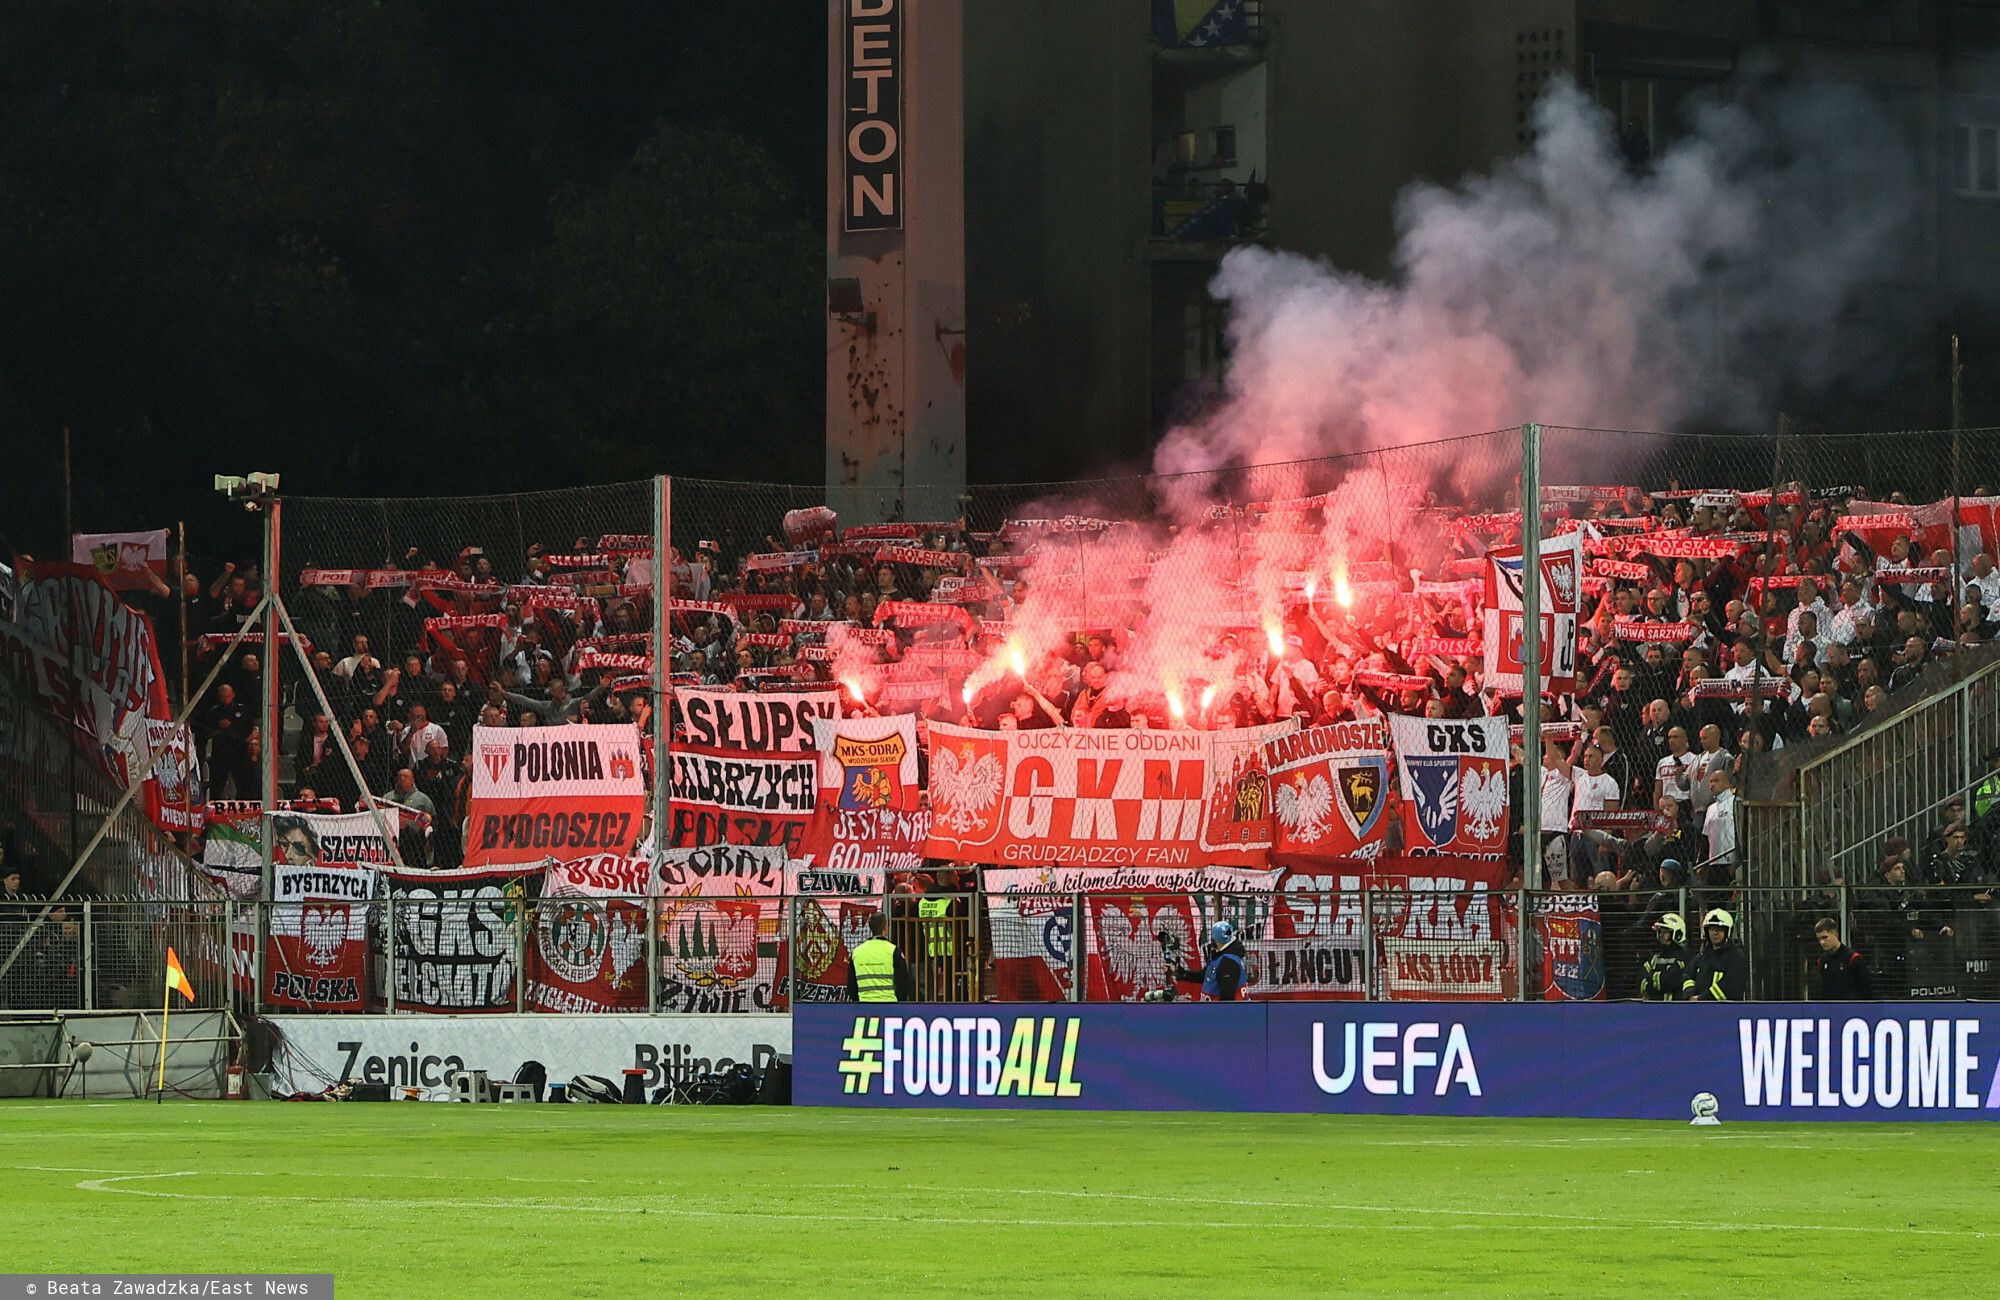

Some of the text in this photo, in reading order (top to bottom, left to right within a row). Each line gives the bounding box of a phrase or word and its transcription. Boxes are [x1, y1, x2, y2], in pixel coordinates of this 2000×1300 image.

[1615, 623, 1645, 639] NOWA
[841, 743, 899, 757] MKS ODRA
[1125, 733, 1201, 751] ODDANI
[1265, 721, 1385, 767] KARKONOSZE
[1427, 724, 1486, 753] GKS
[513, 740, 604, 783] POLONIA
[1007, 756, 1205, 841] GKM
[481, 811, 631, 850] BYDGOSZCZ
[833, 808, 880, 840] JEST
[1004, 844, 1189, 865] GRUDZIĄDZCY FANI
[282, 872, 368, 899] BYSTRZYCA
[564, 856, 649, 895] OLSKA
[796, 872, 873, 894] CZUWAJ
[271, 970, 360, 1003] POLSKA
[338, 1042, 463, 1088] Zenica
[838, 1017, 1083, 1097] #FOOTBALL
[1311, 1021, 1483, 1097] UEFA
[1738, 1017, 1980, 1108] WELCOME
